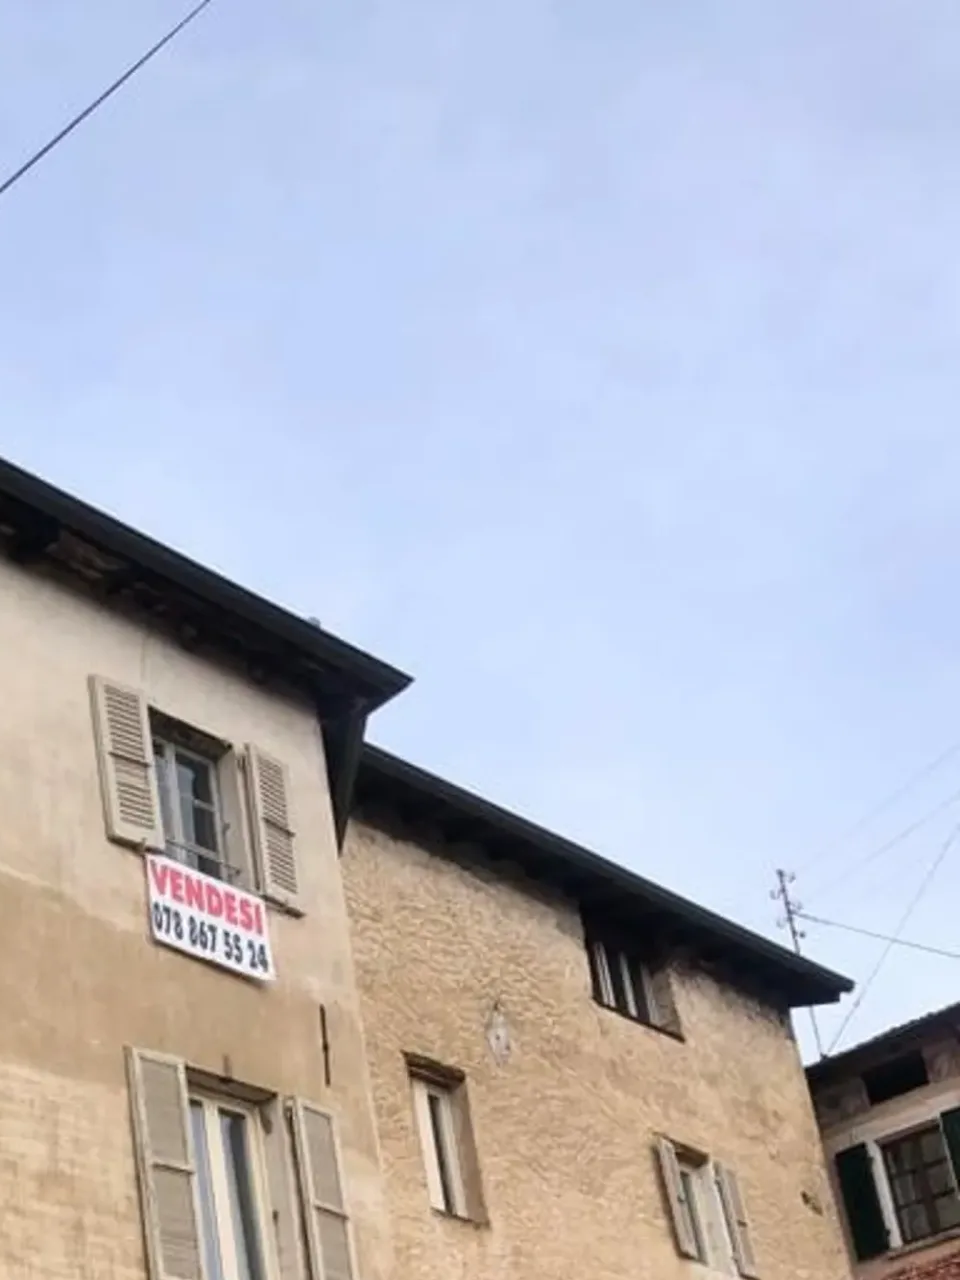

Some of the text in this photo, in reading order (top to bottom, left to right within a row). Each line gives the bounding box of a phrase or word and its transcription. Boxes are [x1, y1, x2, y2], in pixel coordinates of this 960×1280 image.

[150, 859, 263, 936] VENDESI
[153, 902, 184, 940] 078
[189, 915, 217, 952] 867
[223, 930, 243, 964] 55
